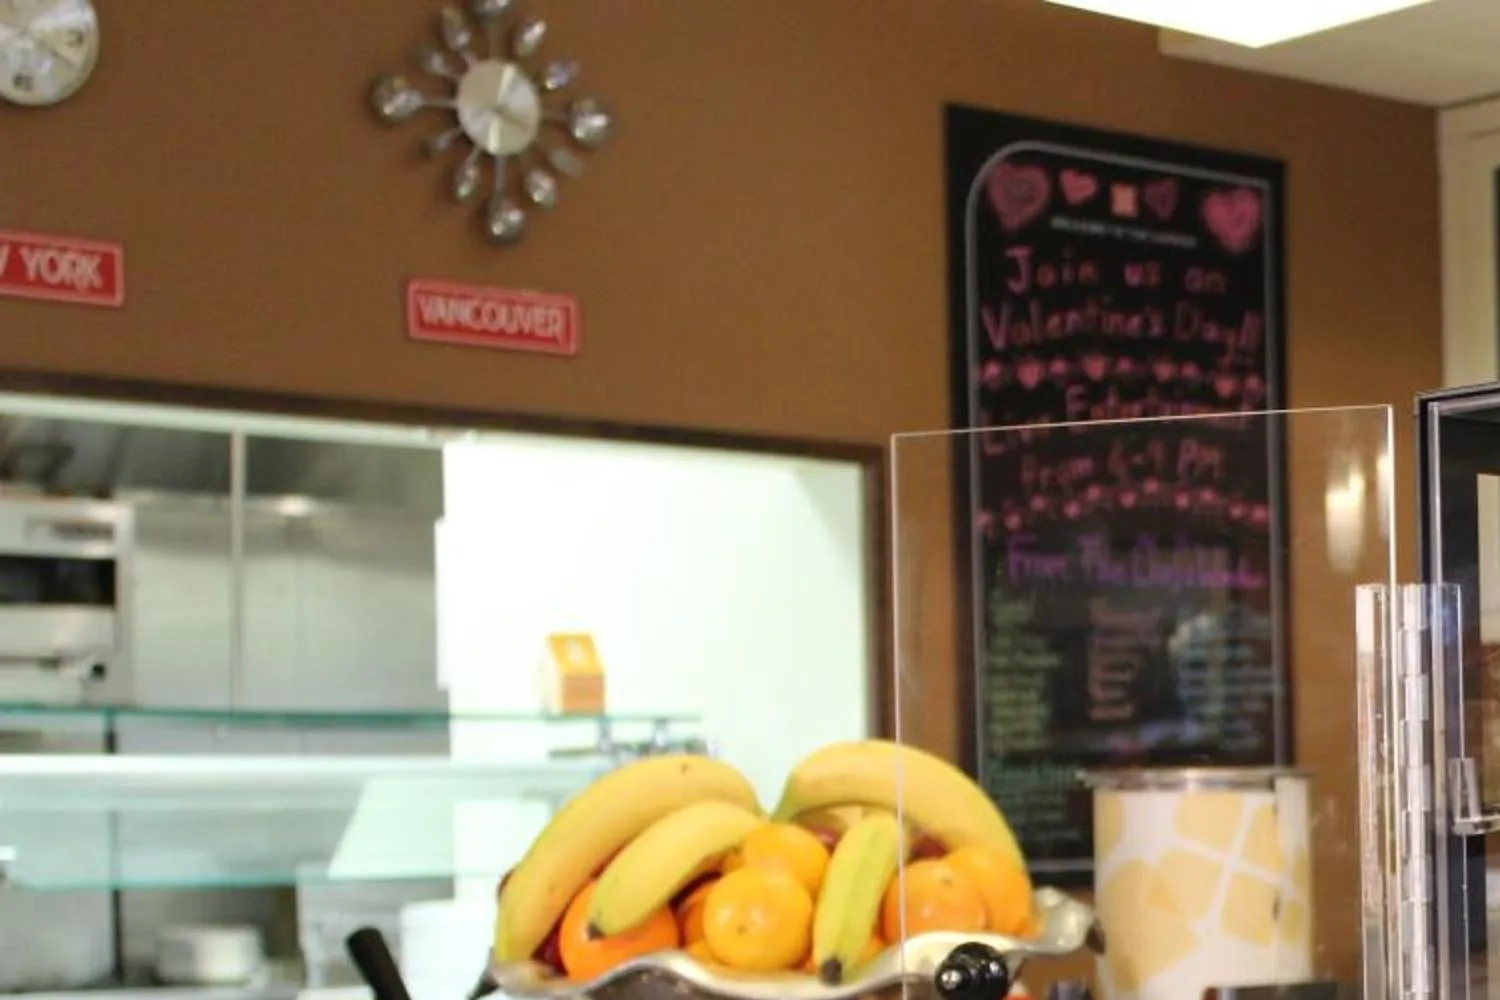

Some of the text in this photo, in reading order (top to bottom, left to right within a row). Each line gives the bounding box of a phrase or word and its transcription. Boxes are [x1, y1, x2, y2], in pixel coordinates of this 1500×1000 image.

[19, 245, 103, 291] YORK
[1004, 246, 1098, 293] Join
[1122, 259, 1162, 288] us
[417, 294, 566, 344] VANCOUVER
[980, 298, 1168, 352] Valentine's
